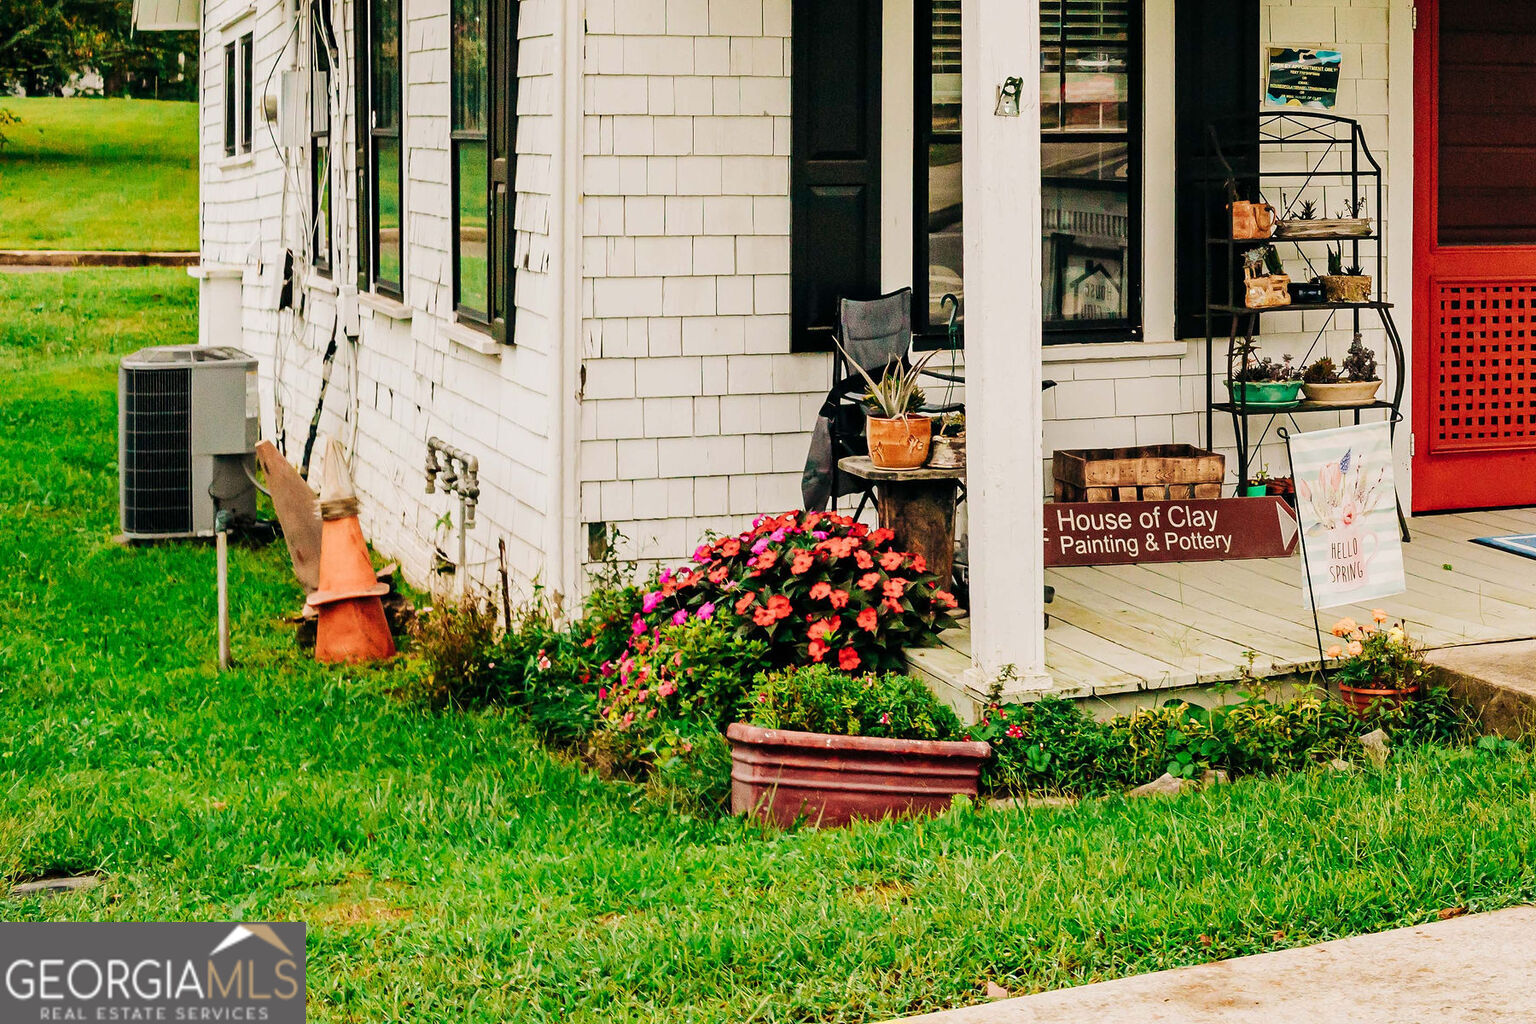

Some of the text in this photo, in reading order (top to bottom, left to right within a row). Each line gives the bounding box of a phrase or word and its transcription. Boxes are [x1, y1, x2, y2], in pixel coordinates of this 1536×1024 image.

[1057, 505, 1218, 533] House of Clay
[1060, 532, 1232, 558] Painting & Pottery
[1331, 537, 1358, 560] HELLO
[1329, 564, 1364, 583] SPRING
